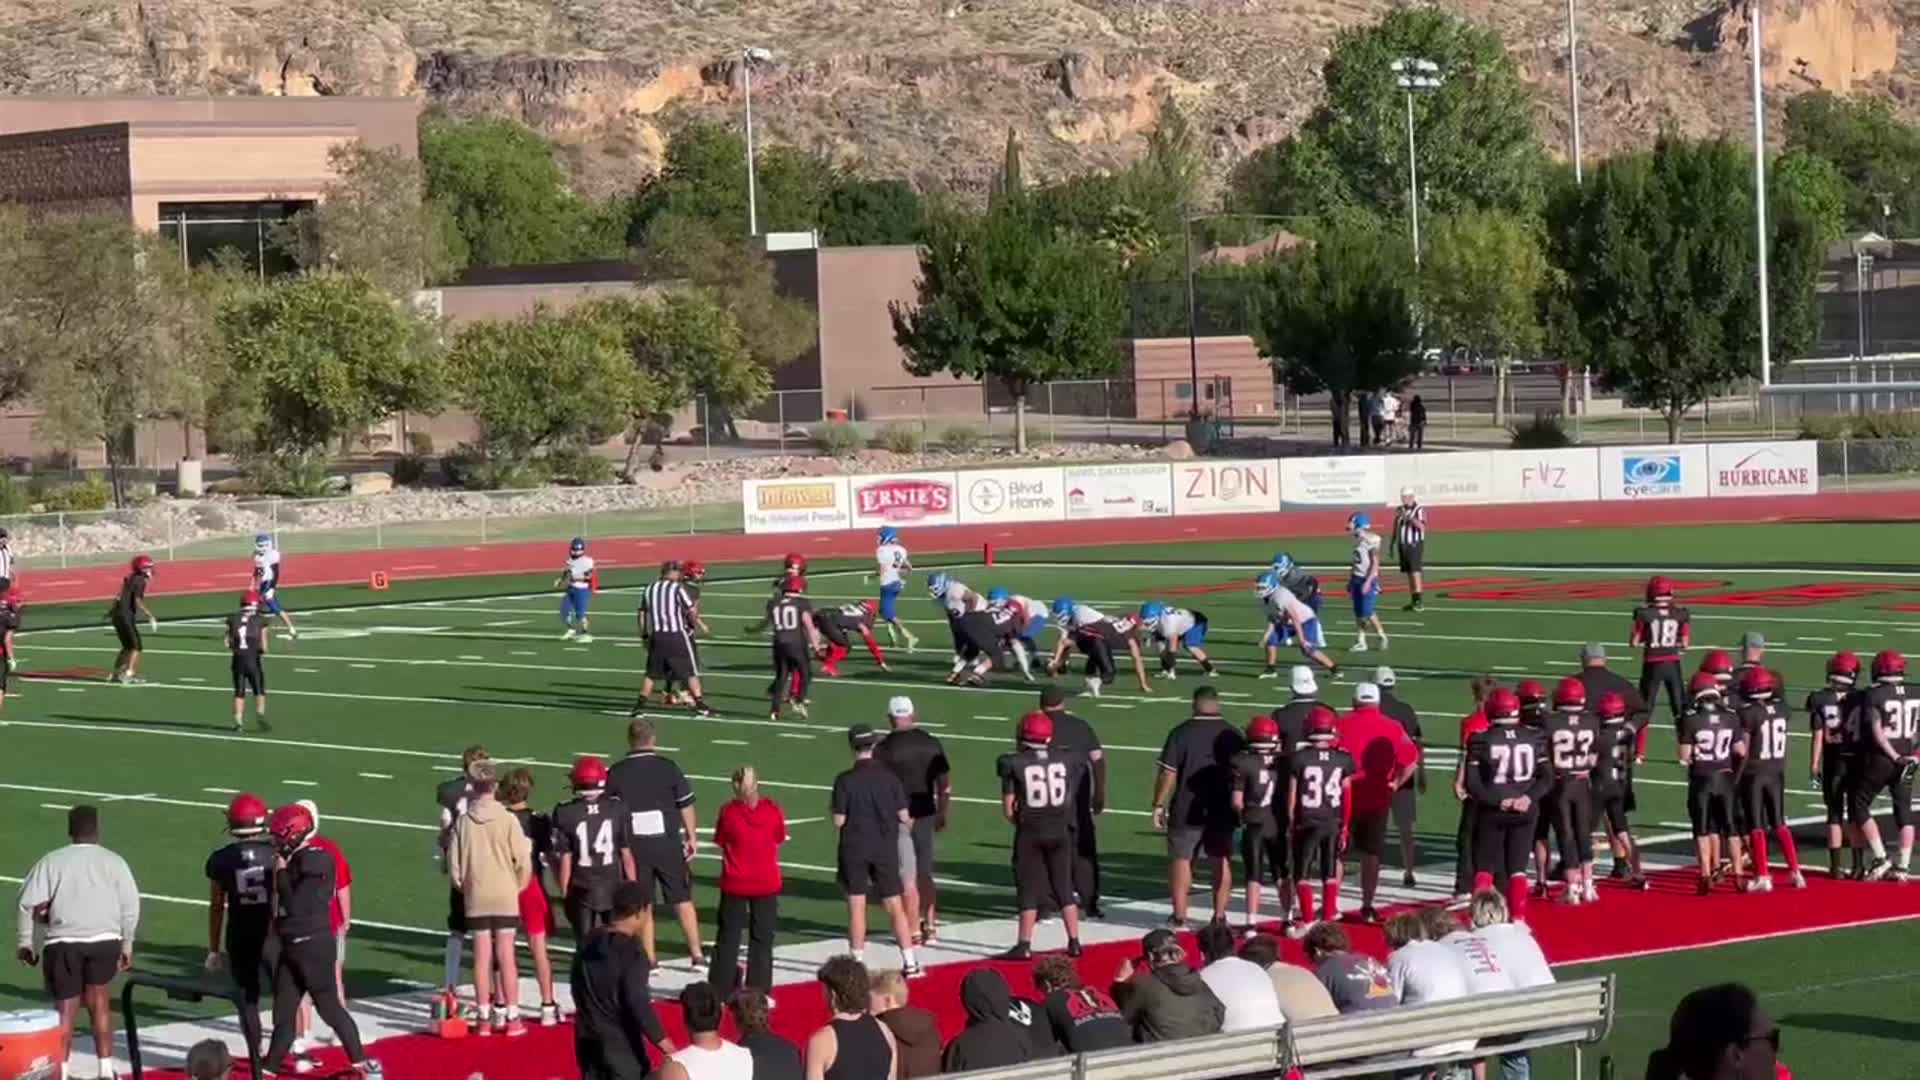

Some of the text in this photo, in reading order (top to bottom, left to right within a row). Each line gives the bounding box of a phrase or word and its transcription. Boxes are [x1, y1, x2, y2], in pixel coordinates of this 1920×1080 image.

[1009, 481, 1043, 495] Blvd
[1185, 467, 1268, 501] ZION
[1719, 469, 1808, 486] HURRICANE
[861, 487, 947, 512] ERNIE'S
[1009, 497, 1054, 509] Home
[773, 605, 798, 630] 10
[1650, 619, 1678, 648] 18
[238, 625, 248, 649] 1
[1885, 699, 1920, 738] 30
[1552, 730, 1594, 768] 23
[1695, 729, 1733, 760] 20
[1490, 744, 1534, 784] 70
[1024, 762, 1066, 808] 66
[1301, 765, 1342, 808] 34
[576, 819, 614, 866] 14
[235, 866, 268, 905] 5
